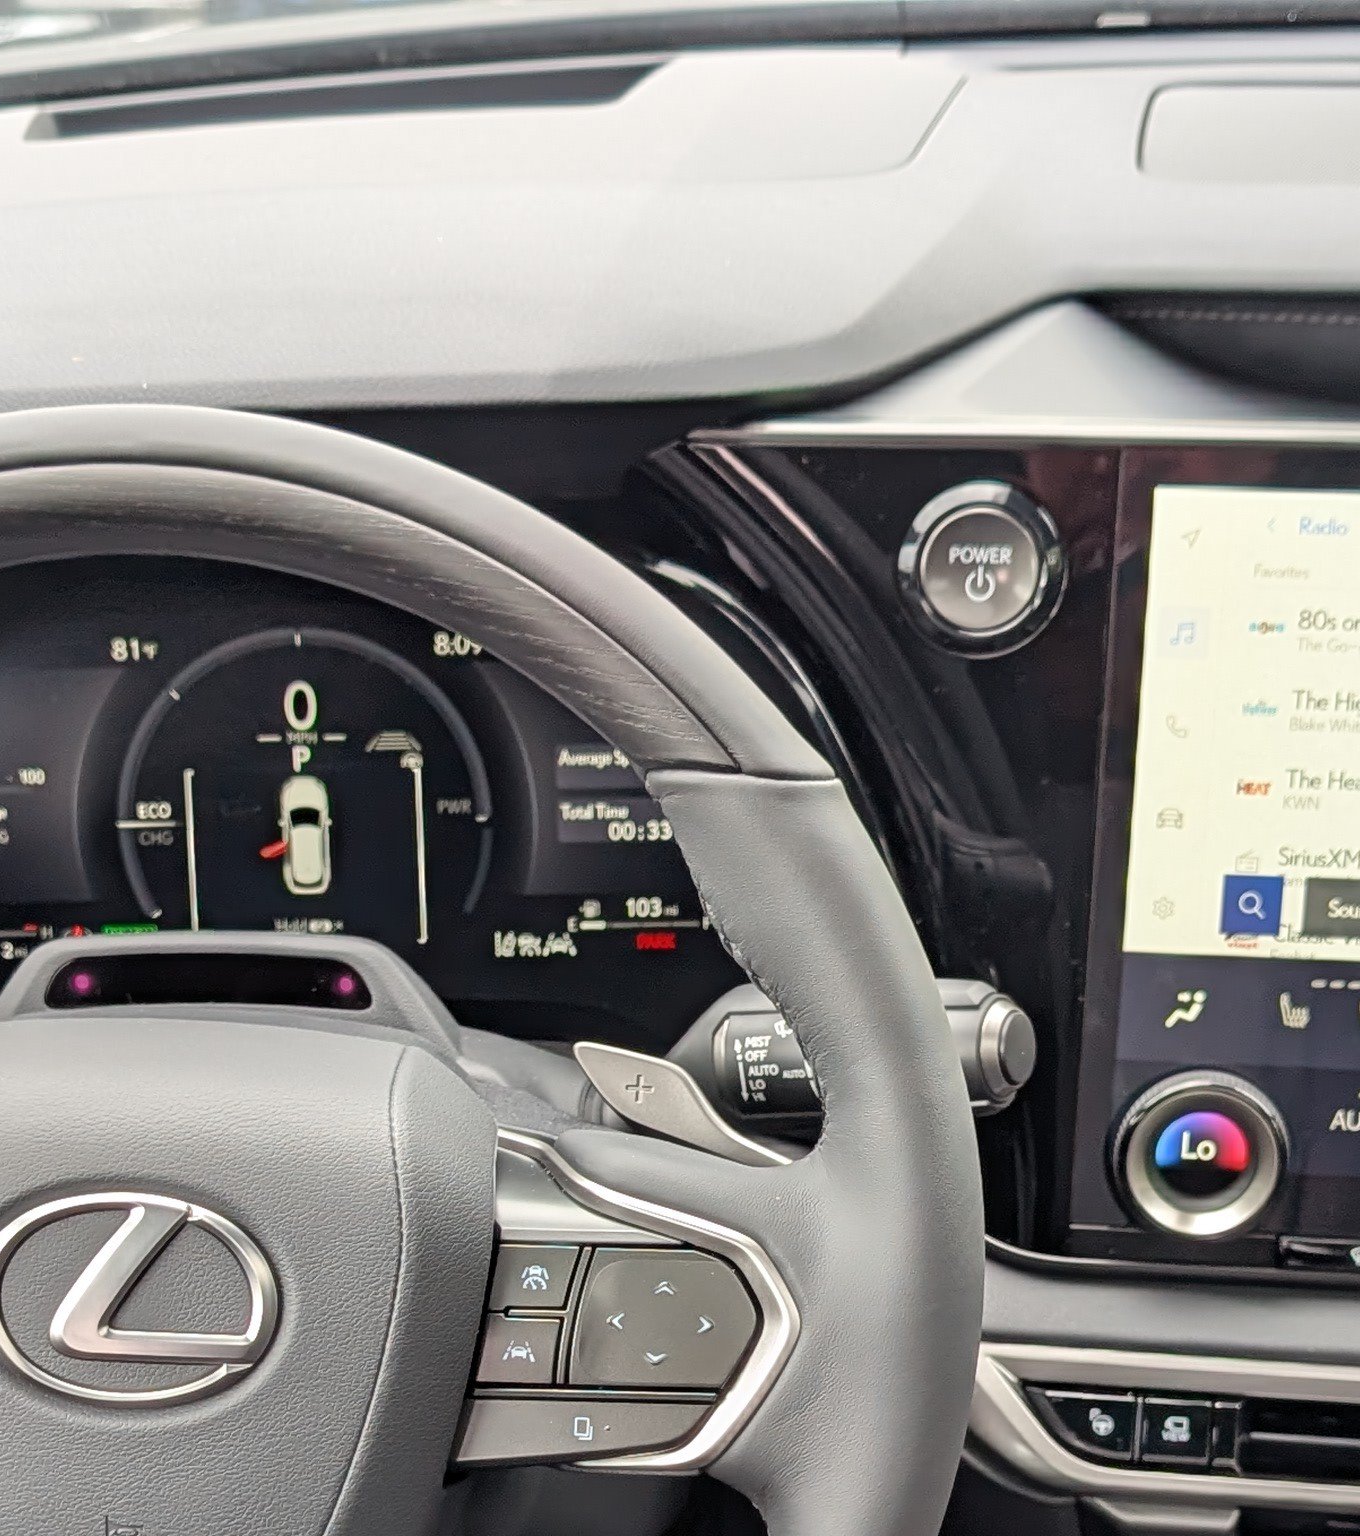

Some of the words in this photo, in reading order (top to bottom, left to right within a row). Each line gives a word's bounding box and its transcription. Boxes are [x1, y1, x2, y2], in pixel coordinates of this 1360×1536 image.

[1298, 516, 1348, 536] Radio
[949, 544, 1014, 566] POWER
[1297, 609, 1337, 632] 80s
[1297, 636, 1323, 653] The
[283, 679, 318, 732] 0
[1291, 689, 1328, 712] The
[291, 744, 312, 773] P
[558, 748, 612, 769] Average
[17, 766, 46, 786] 100
[1285, 769, 1322, 791] The
[135, 801, 172, 819] ECO
[436, 799, 472, 815] PWR
[559, 801, 594, 821] Total
[595, 802, 630, 821] Time
[625, 896, 663, 918] 103
[566, 915, 580, 933] E
[744, 1035, 772, 1048] MIST
[744, 1049, 768, 1063] OFF
[748, 1063, 780, 1078] AUTO
[782, 1068, 807, 1079] AUTO
[748, 1078, 767, 1091] LO
[1180, 1131, 1217, 1164] Lo
